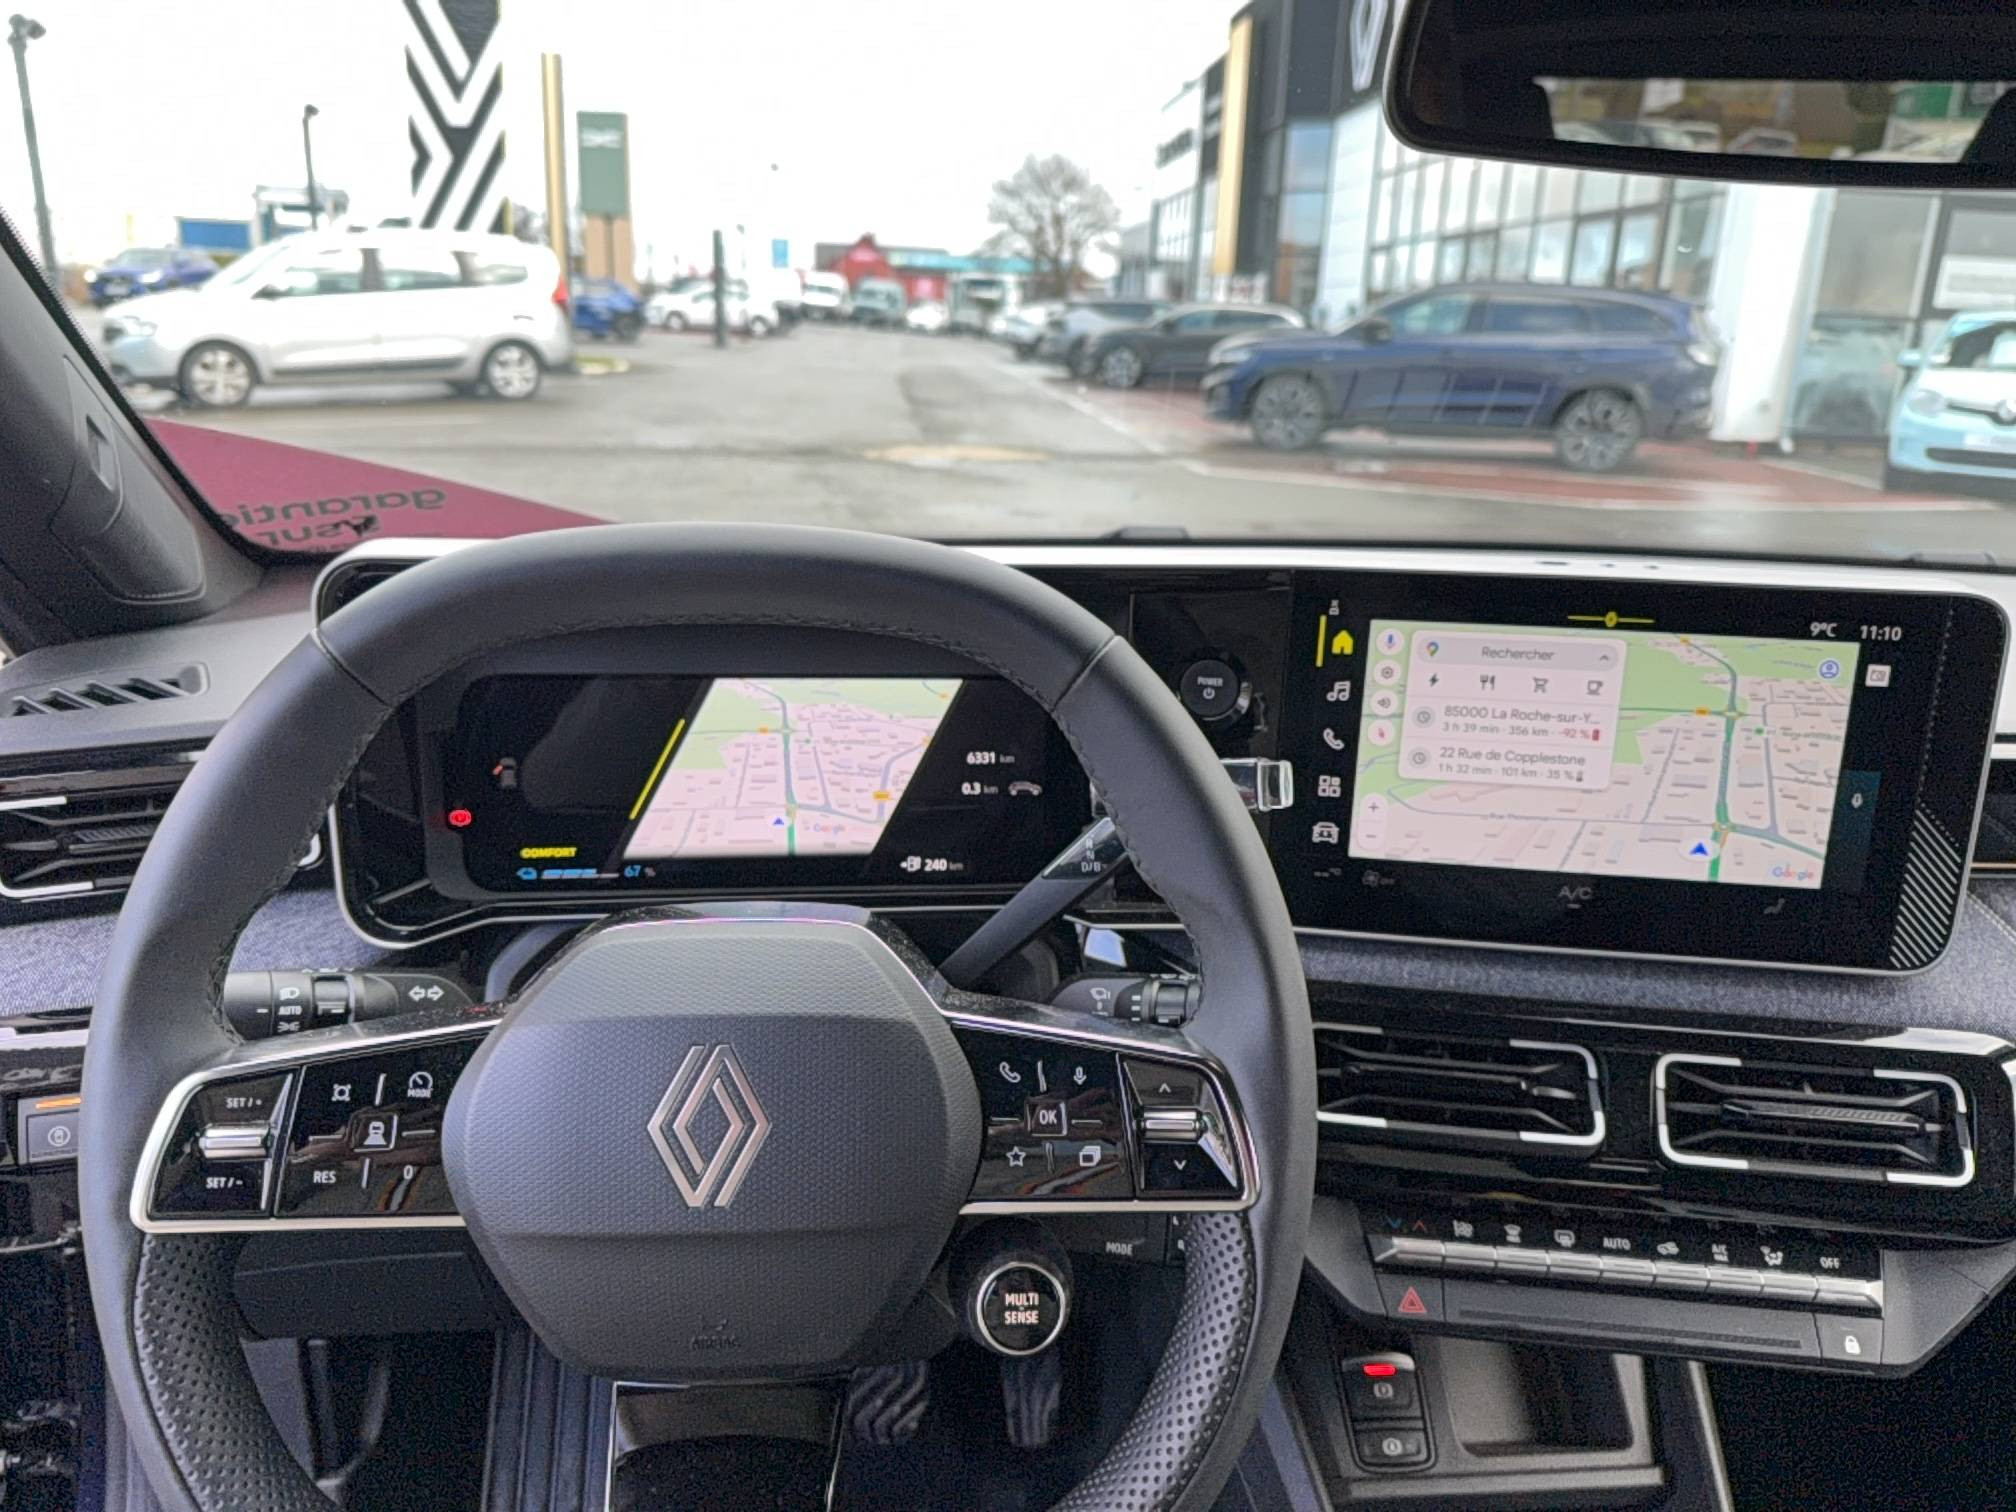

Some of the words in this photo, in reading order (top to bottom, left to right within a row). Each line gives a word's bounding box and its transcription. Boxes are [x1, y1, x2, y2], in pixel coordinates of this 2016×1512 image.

[1860, 625, 1902, 641] 11:10
[1481, 646, 1555, 661] Rechercher
[1444, 706, 1488, 719] 85000
[1492, 708, 1507, 720] La
[1442, 722, 1449, 731] 3
[1453, 722, 1460, 732] h
[1463, 723, 1477, 733] 39
[1480, 724, 1499, 734] min
[1509, 725, 1529, 736] 356
[1532, 726, 1549, 737] km
[966, 752, 996, 764] 6331
[1000, 754, 1015, 763] km
[1440, 747, 1455, 758] 22
[1458, 748, 1482, 760] Rue
[1485, 749, 1501, 761] de
[1504, 750, 1586, 766] Copplestone
[1446, 763, 1453, 773] h
[1456, 764, 1469, 774] 32
[1472, 765, 1492, 775] min
[1502, 767, 1519, 777] 101
[1520, 767, 1537, 778] km
[1546, 770, 1561, 779] 35
[961, 782, 981, 795] 0.3
[984, 784, 998, 793] km
[520, 847, 577, 858] COMFORT
[623, 865, 641, 877] 67
[924, 858, 947, 871] 240
[949, 861, 963, 871] km
[1558, 885, 1592, 899] A/C
[278, 1005, 302, 1015] AUTO
[1039, 1110, 1057, 1125] OK
[313, 1170, 336, 1184] RES
[1105, 1242, 1133, 1255] MODE
[1603, 1237, 1631, 1250] AUTO
[1820, 1256, 1839, 1268] OFF
[1005, 1292, 1039, 1307] MULTI
[1004, 1311, 1039, 1325] SENSE
